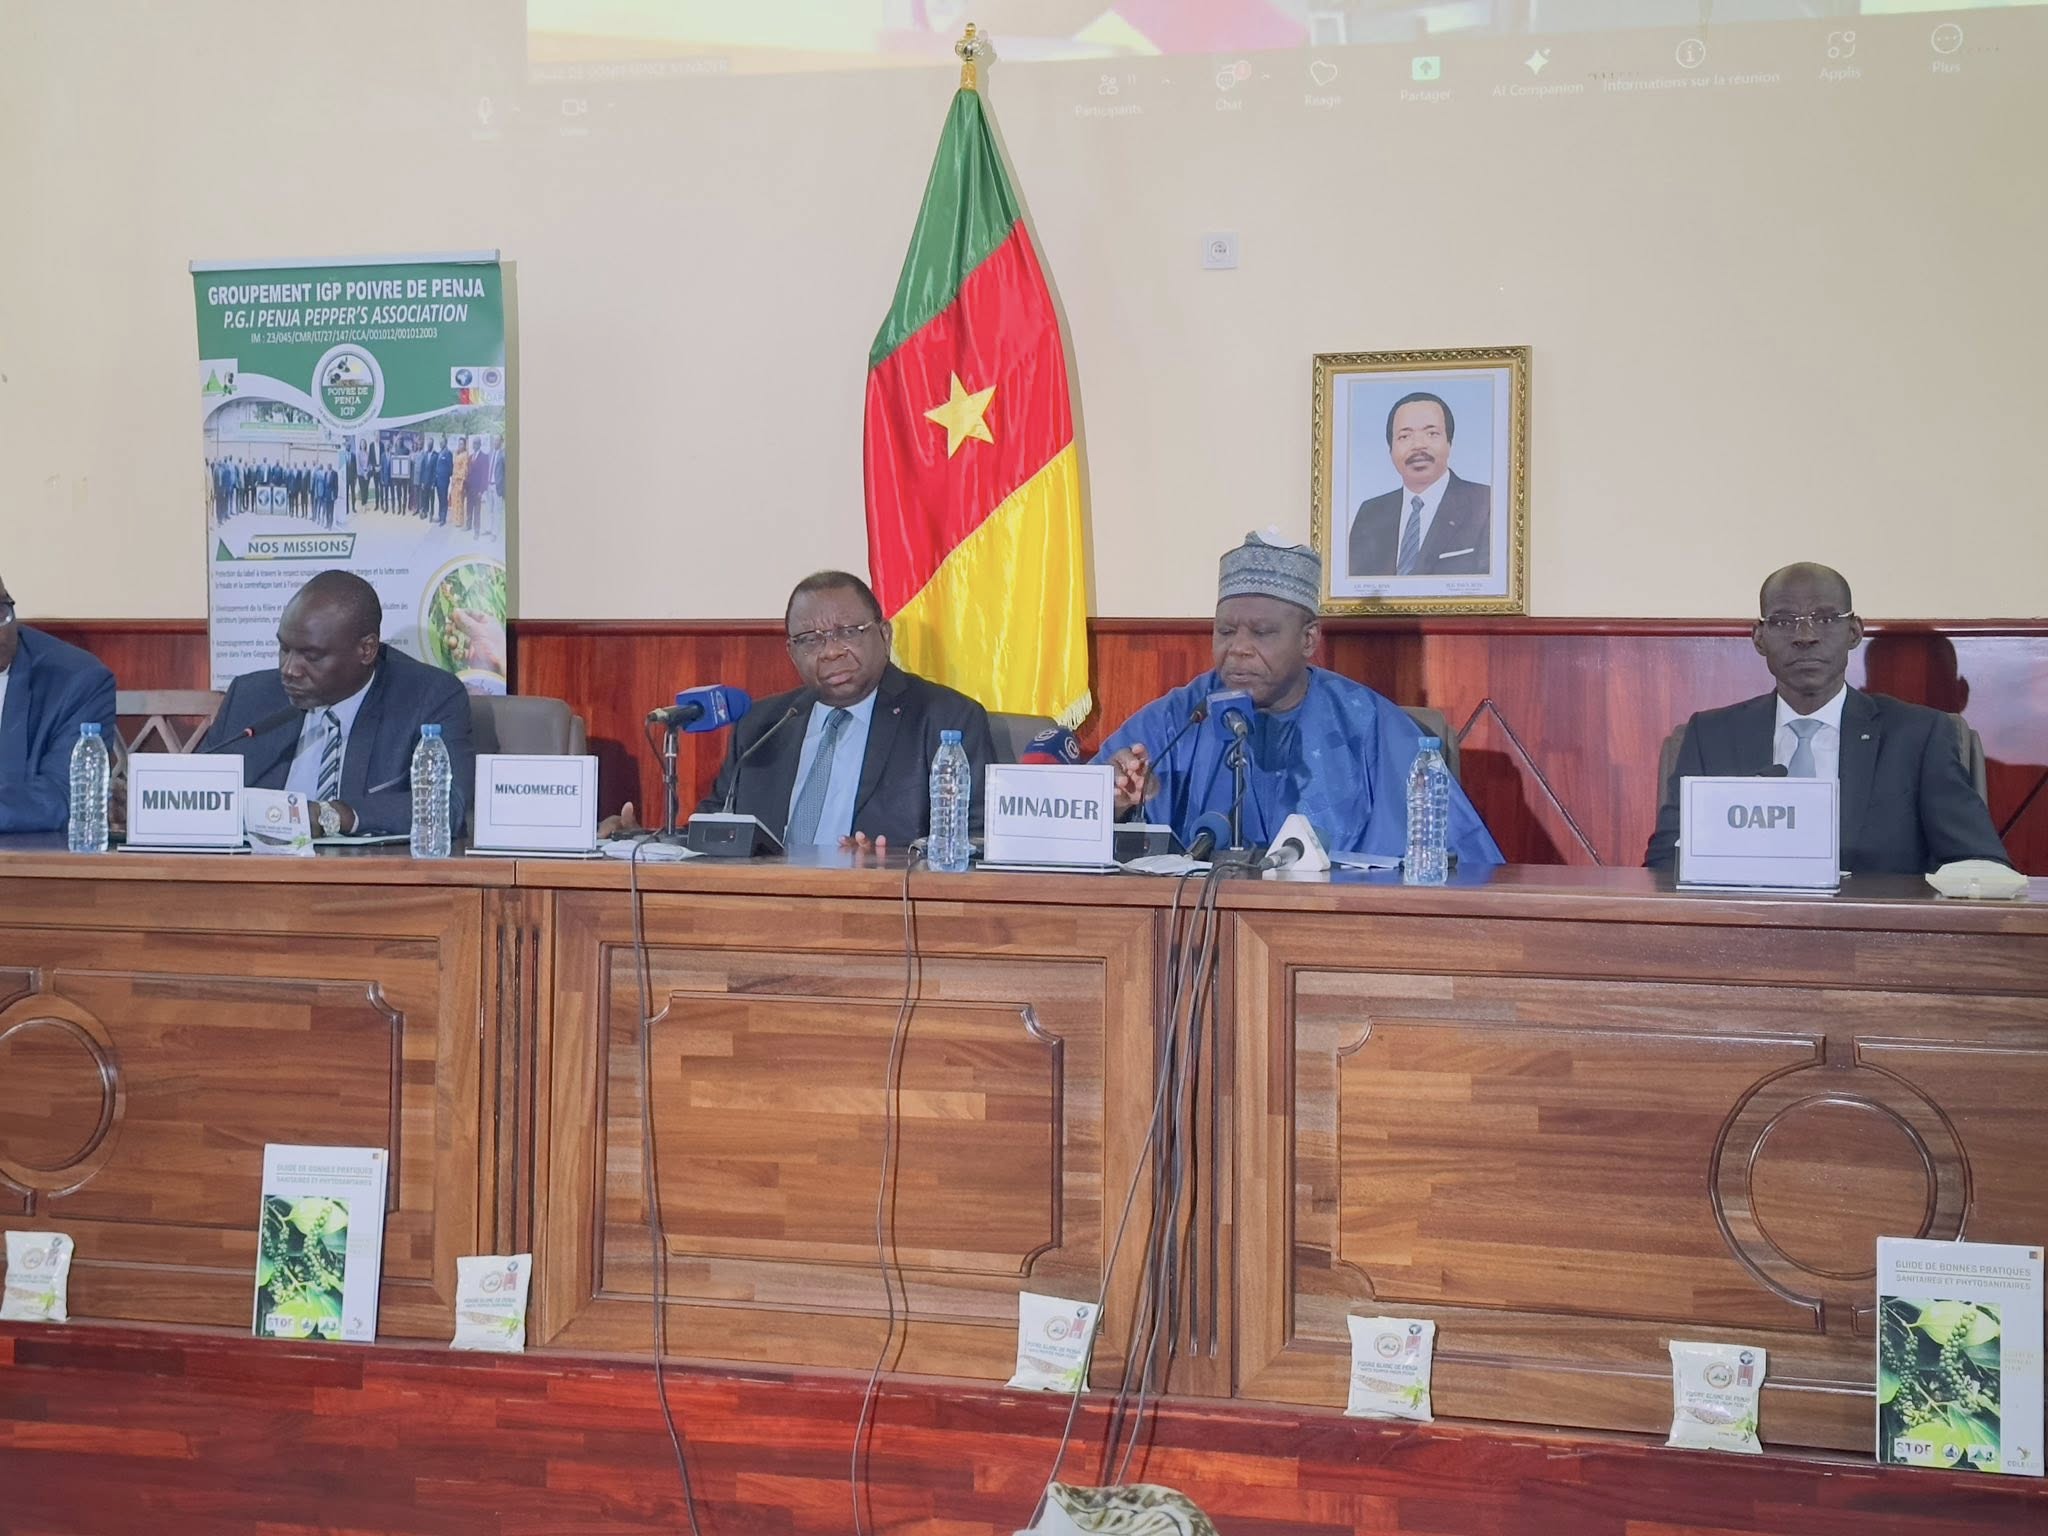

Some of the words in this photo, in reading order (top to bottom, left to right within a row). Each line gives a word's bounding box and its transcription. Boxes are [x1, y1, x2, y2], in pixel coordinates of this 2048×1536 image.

[1931, 61, 1961, 74] Plus
[1509, 81, 1585, 100] Companion
[1604, 77, 1688, 93] Informations
[1690, 76, 1712, 88] sur
[1714, 74, 1726, 86] la
[1215, 98, 1243, 112] Chat
[208, 283, 312, 305] GROUPEMENT
[316, 282, 341, 301] IGP
[346, 280, 402, 300] POIVRE
[407, 279, 427, 298] DE
[432, 278, 485, 298] PENJA
[224, 309, 254, 328] P.G.I
[258, 308, 301, 328] PENJA
[304, 305, 368, 327] PEPPER'S
[371, 303, 468, 324] ASSOCIATION
[251, 333, 260, 343] IM
[327, 387, 357, 396] POIVRE
[358, 386, 369, 395] DE
[334, 396, 362, 406] PENJA
[248, 541, 279, 553] NOS
[283, 540, 349, 553] MISSIONS
[494, 783, 580, 796] MINCOMMERCE
[142, 790, 234, 811] MINMIDT
[999, 795, 1099, 821] MINADER
[1727, 804, 1797, 830] OAPI
[1895, 1260, 1923, 1271] GUIDE
[1925, 1261, 1937, 1271] DE
[1939, 1262, 1977, 1274] BONNES
[1979, 1265, 2031, 1277] PRATIQUES
[1896, 1274, 1941, 1285] SANITAIRES
[1944, 1277, 1953, 1286] ET
[1955, 1278, 2031, 1291] PHYTOSANITAIRES
